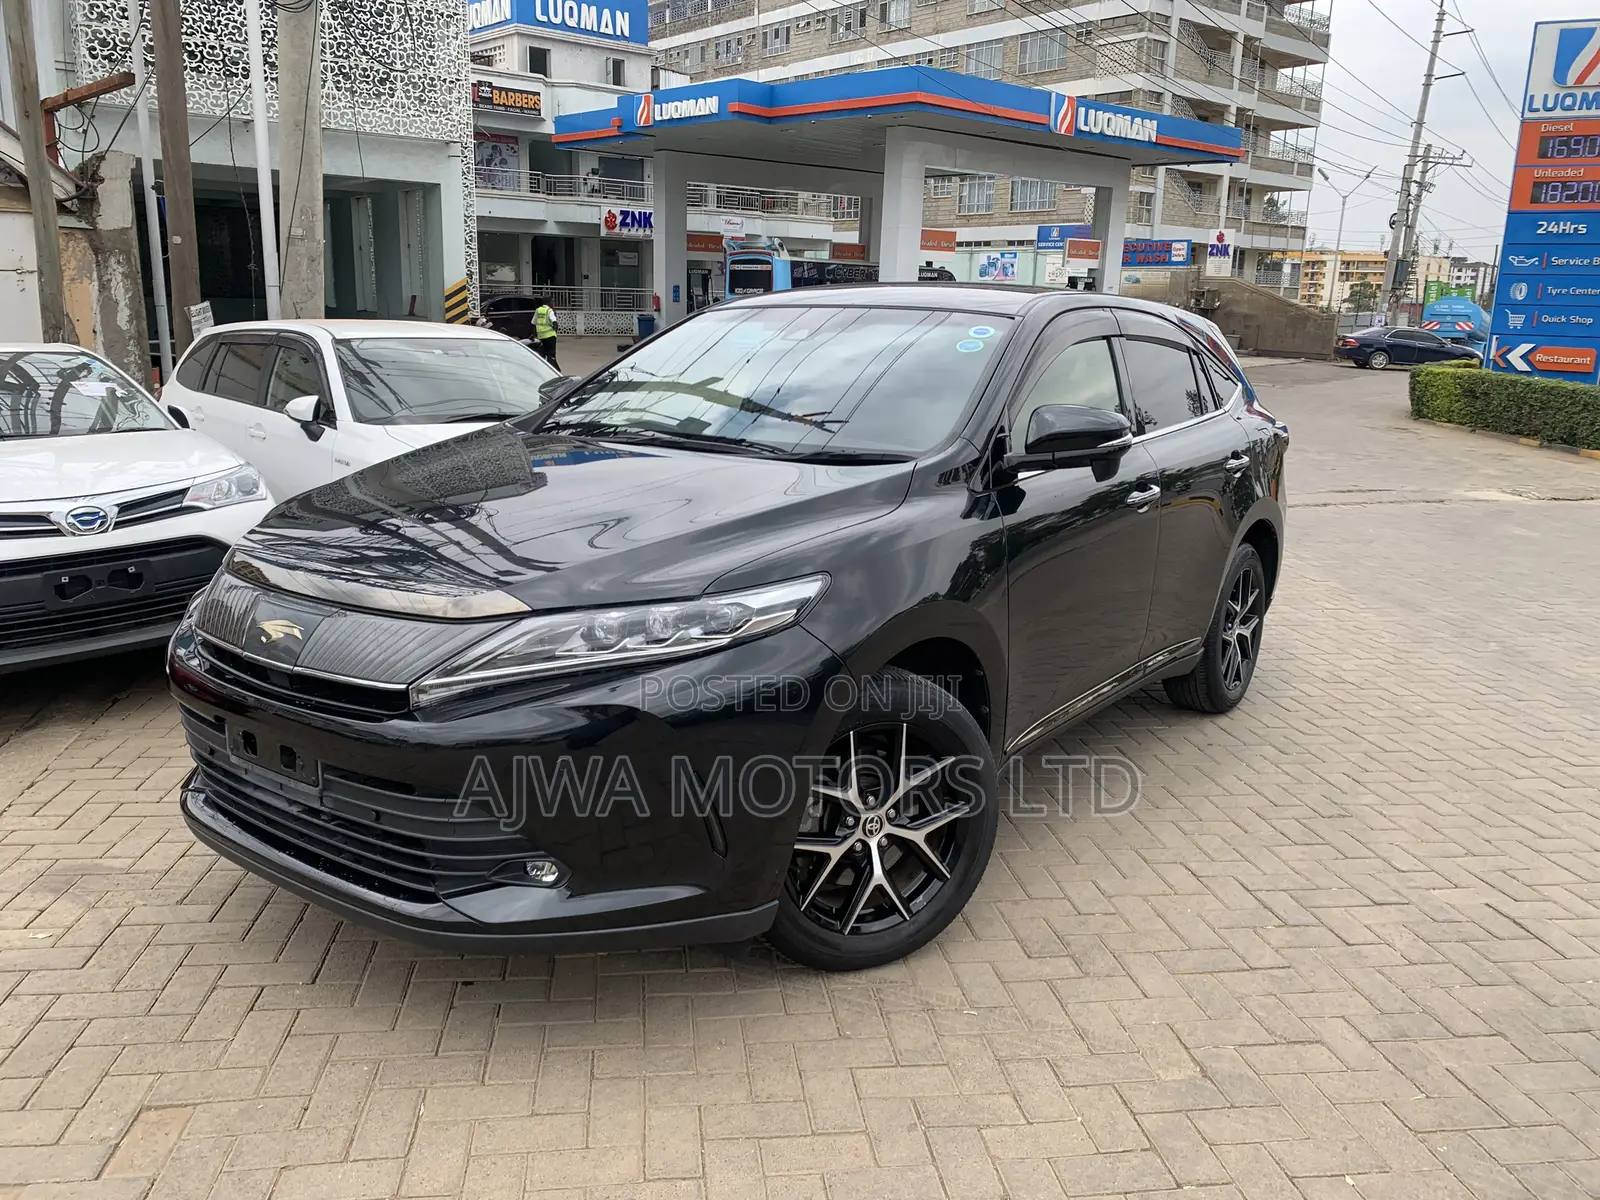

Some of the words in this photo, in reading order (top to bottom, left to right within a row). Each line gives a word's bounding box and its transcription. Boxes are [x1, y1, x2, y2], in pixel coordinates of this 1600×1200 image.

[469, 0, 512, 30] UQMAN
[535, 0, 630, 37] LUQMAN
[492, 89, 541, 110] BARBERS
[1527, 91, 1600, 113] LUQM
[654, 96, 719, 121] LUQMAN
[1077, 107, 1158, 143] LUQMAN
[1541, 122, 1574, 132] Diesel
[1533, 168, 1584, 178] Unleaded
[619, 209, 654, 229] ZNK
[1536, 221, 1588, 235] 24Hrs
[1123, 241, 1172, 253] ECUTIVE
[1208, 243, 1231, 257] ZNK
[1123, 254, 1131, 264] R
[1136, 253, 1169, 264] WASH
[1551, 256, 1591, 266] Service
[1592, 256, 1600, 266] B
[1547, 286, 1568, 296] Tyre
[1569, 286, 1600, 295] Center
[1541, 314, 1567, 323] Quick
[1570, 315, 1593, 325] Shop
[1535, 353, 1591, 365] Restaurant
